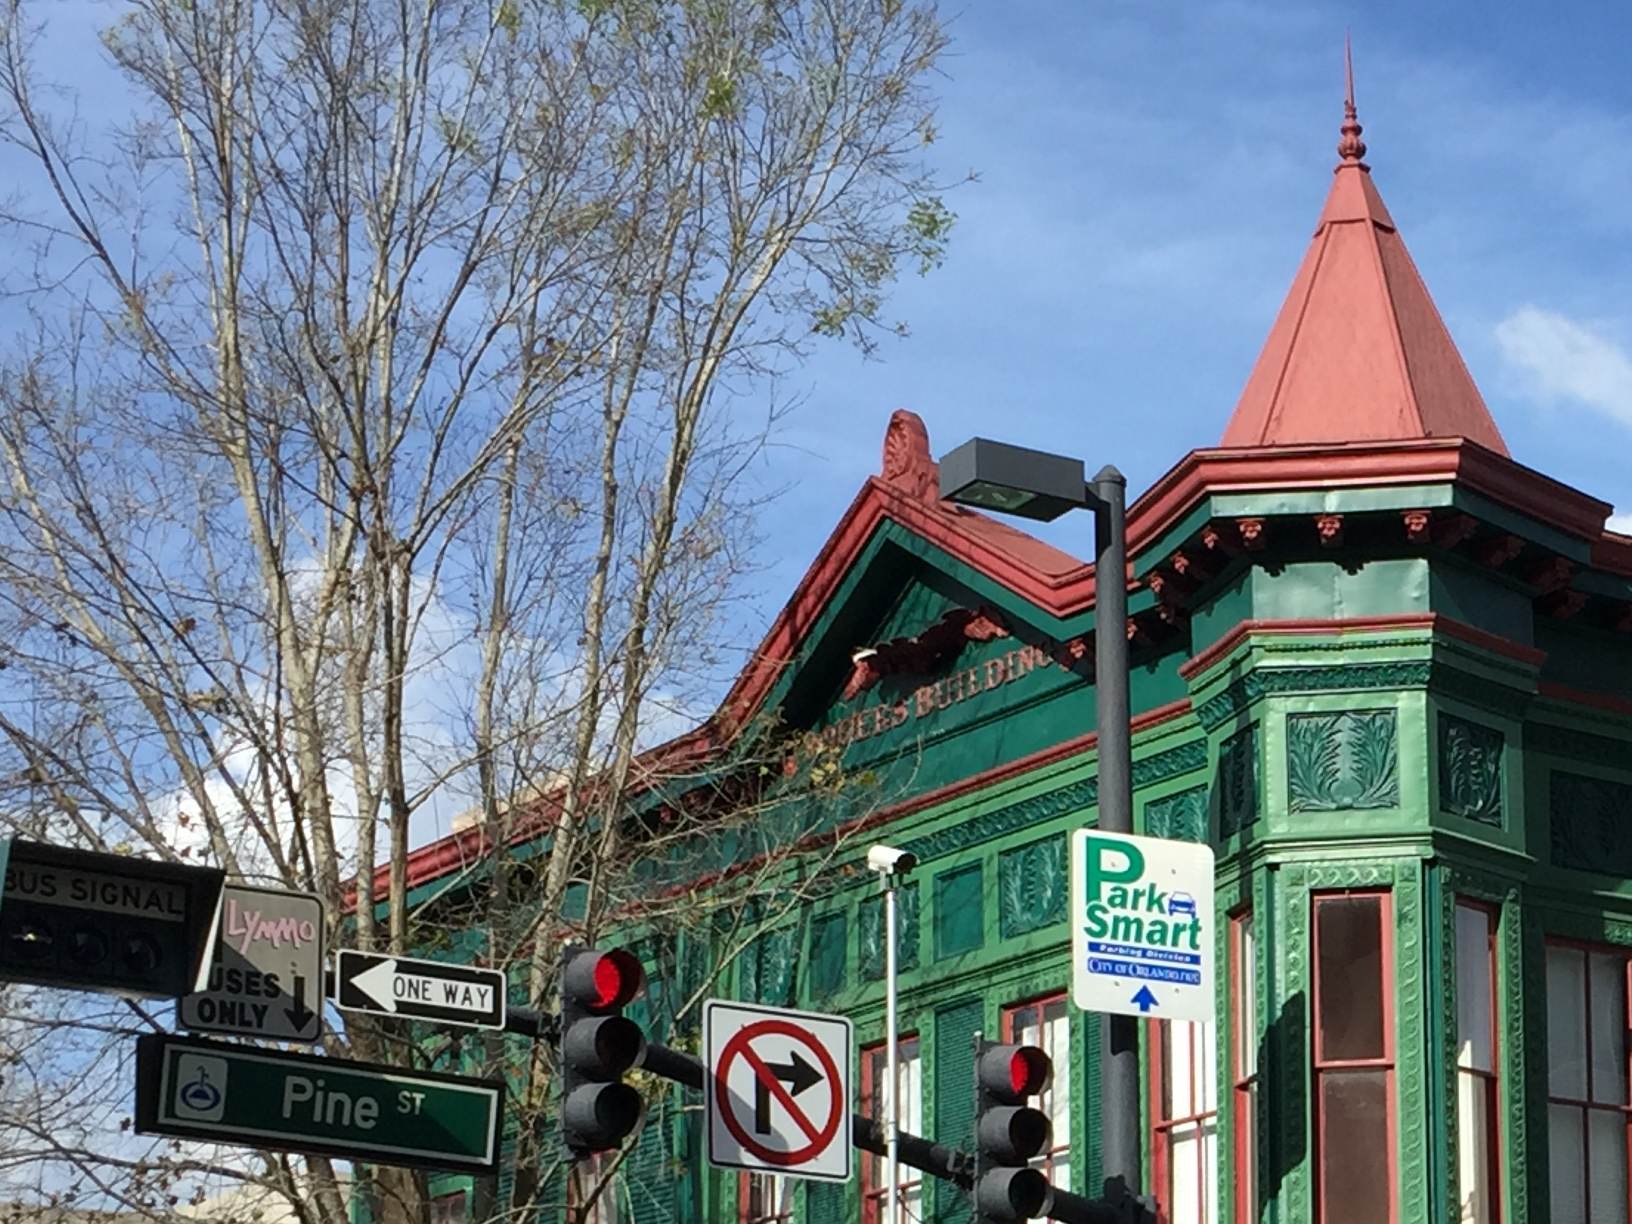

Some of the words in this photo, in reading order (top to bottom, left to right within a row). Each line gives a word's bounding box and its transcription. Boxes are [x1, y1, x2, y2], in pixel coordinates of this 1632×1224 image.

[914, 645, 1054, 720] BUILDING
[5, 869, 57, 897] BUS
[70, 878, 183, 915] SIGNAL
[1085, 835, 1168, 914] Park
[1083, 904, 1202, 950] Smart
[197, 998, 269, 1029] ONLY
[393, 976, 432, 1001] ONE
[443, 983, 490, 1009] WAY
[282, 1075, 379, 1131] Pine
[398, 1090, 426, 1116] ST
